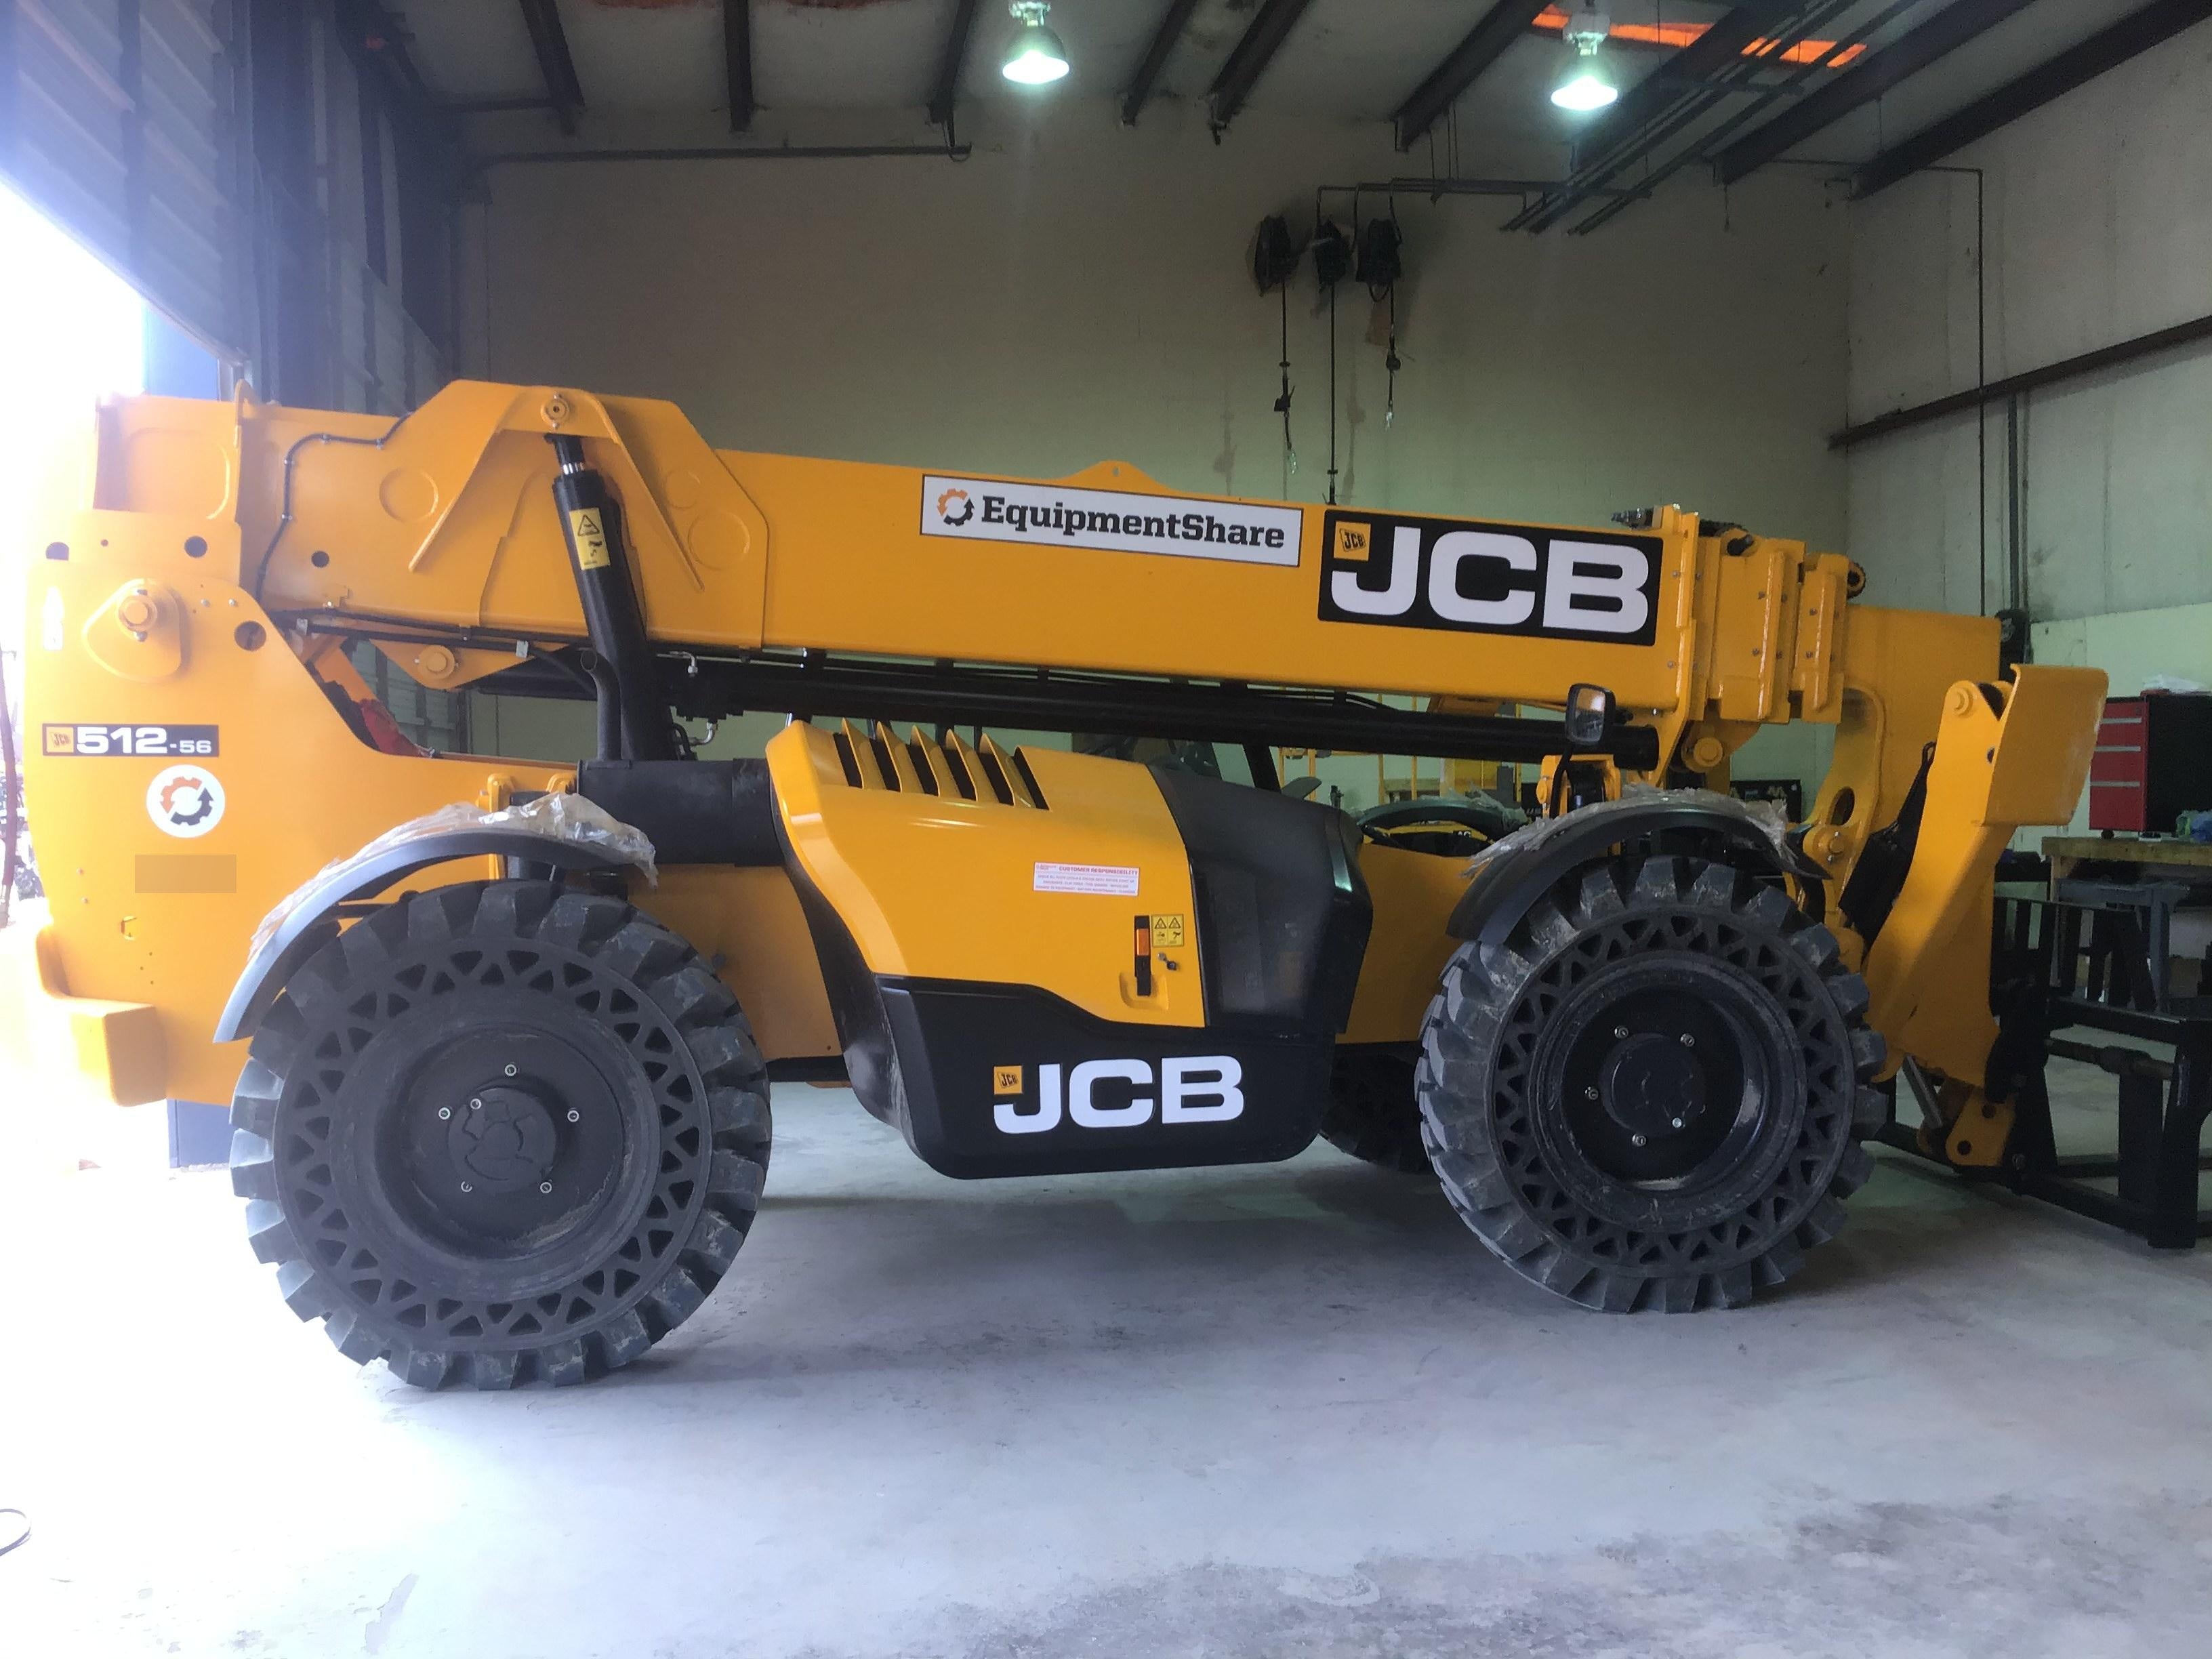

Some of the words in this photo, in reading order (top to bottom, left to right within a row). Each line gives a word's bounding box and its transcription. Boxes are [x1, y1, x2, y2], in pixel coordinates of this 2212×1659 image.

[981, 495, 1285, 548] EquipmentShare
[1344, 531, 1364, 550] JCB
[1331, 525, 1650, 634] JCB
[76, 726, 212, 754] 512-56
[994, 1055, 1244, 1134] JCB
[1001, 1073, 1018, 1087] JCB
